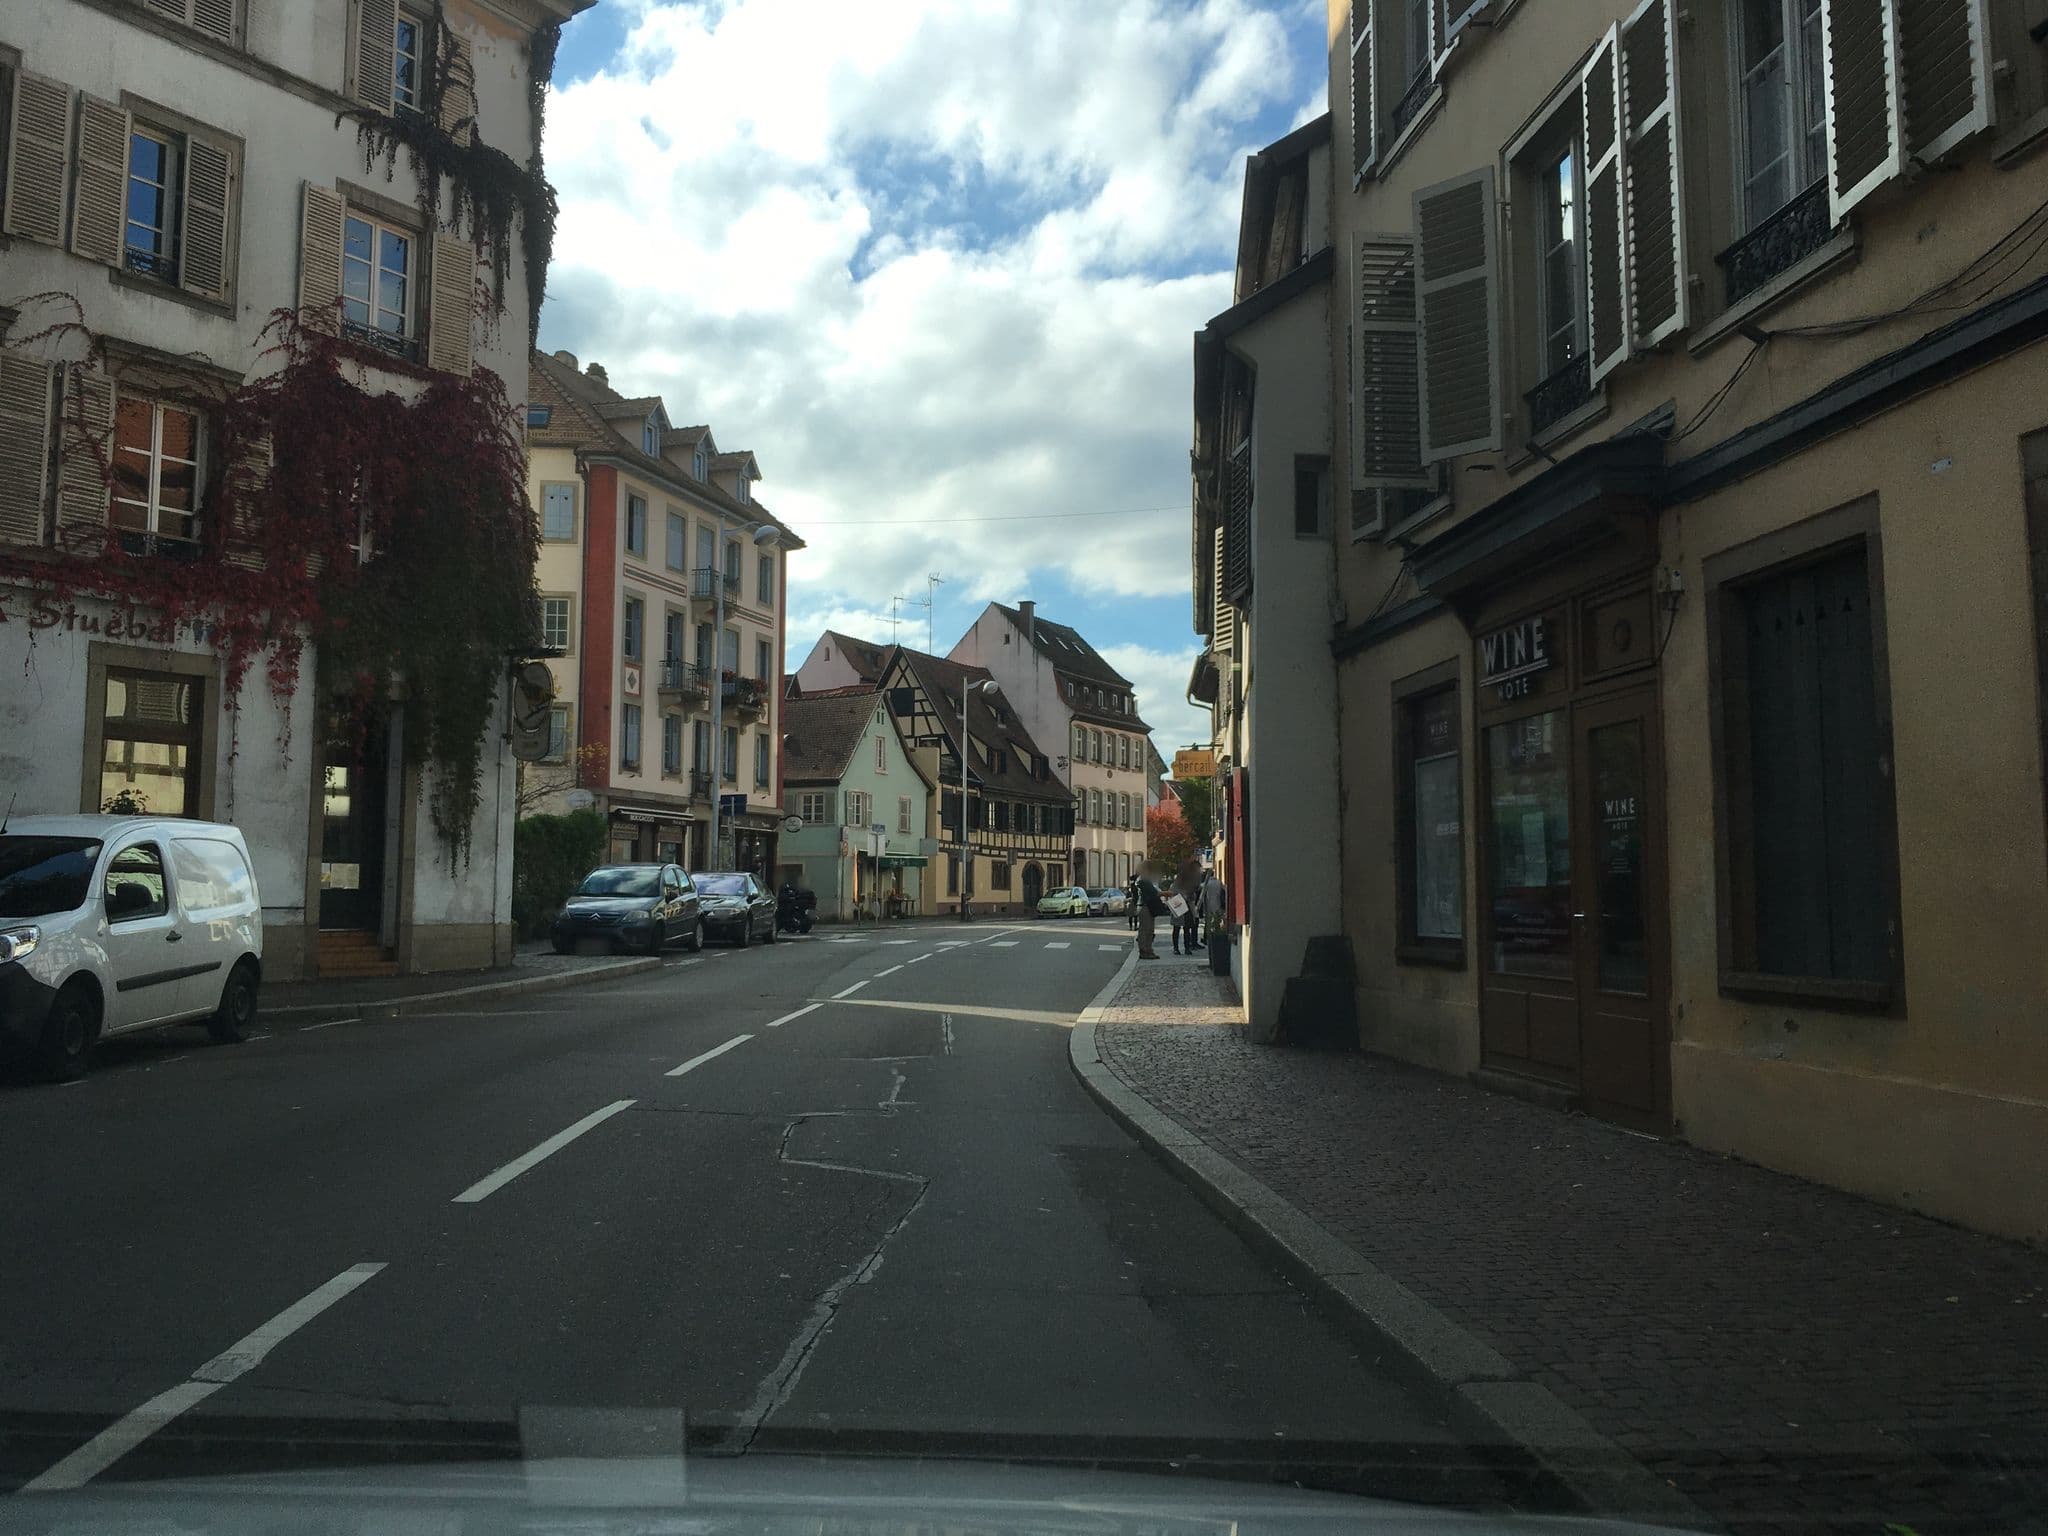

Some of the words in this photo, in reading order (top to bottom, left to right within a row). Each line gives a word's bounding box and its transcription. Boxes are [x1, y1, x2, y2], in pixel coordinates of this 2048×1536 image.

[1481, 614, 1546, 673] WINE
[1496, 677, 1530, 703] NOTE
[1605, 797, 1635, 816] WINE
